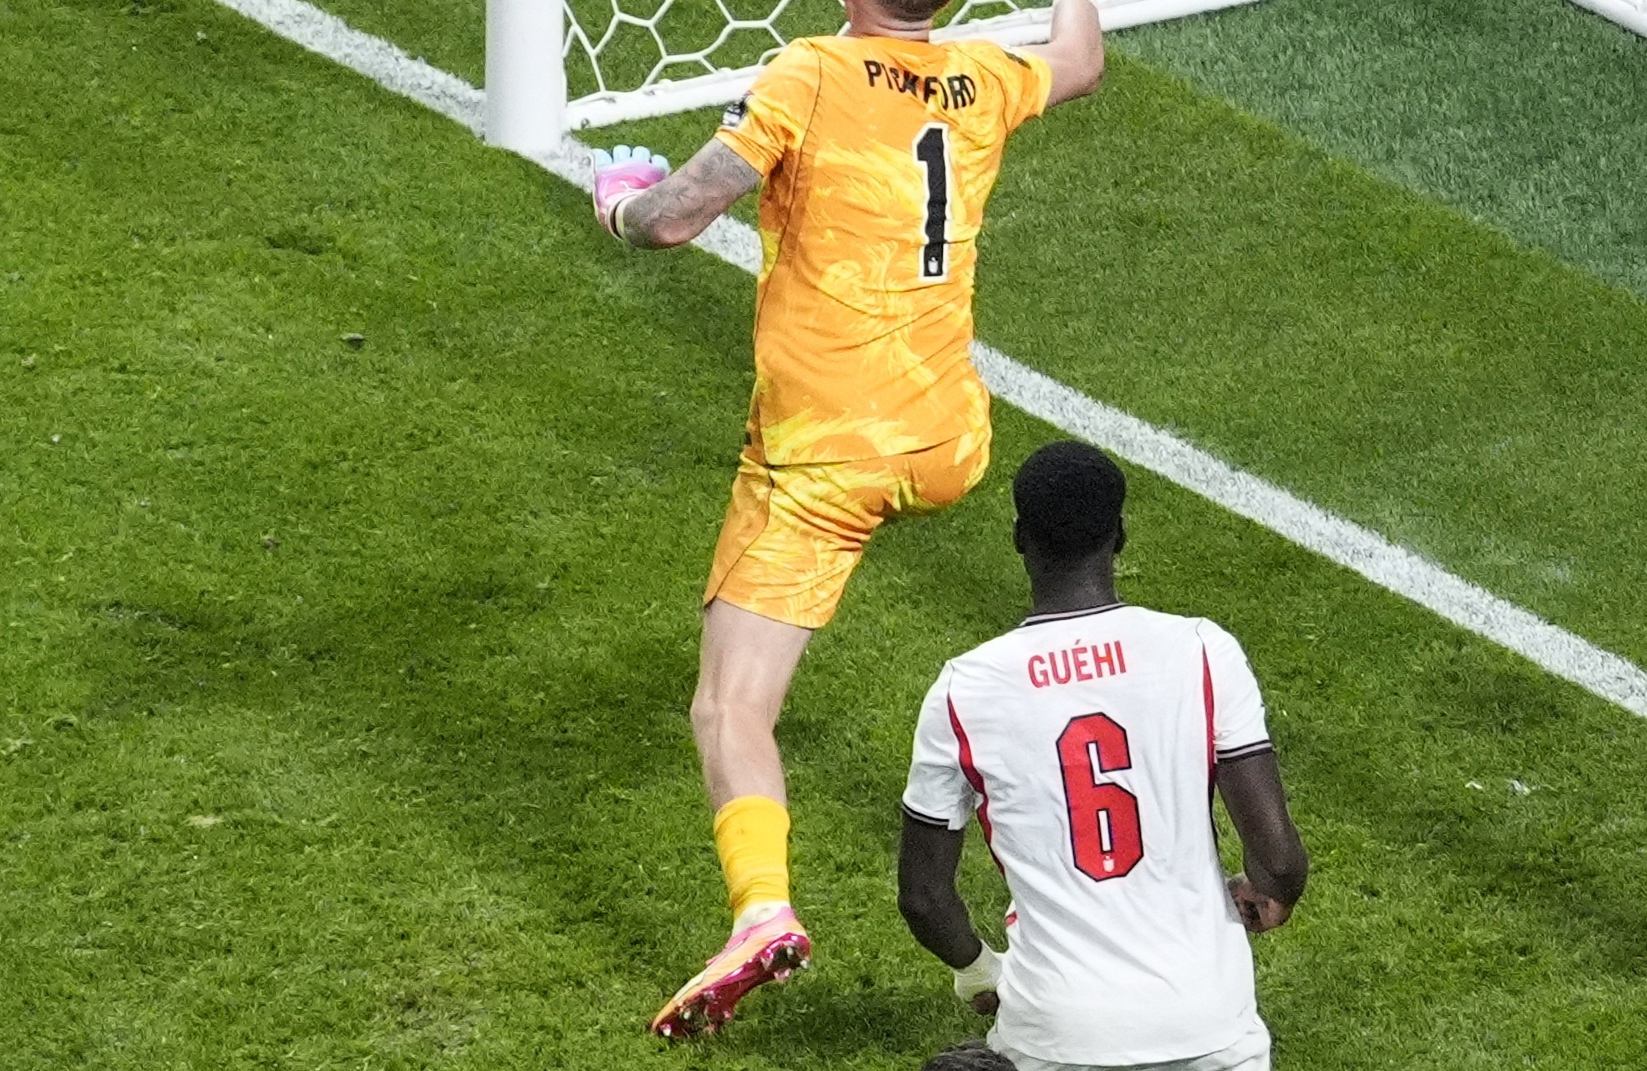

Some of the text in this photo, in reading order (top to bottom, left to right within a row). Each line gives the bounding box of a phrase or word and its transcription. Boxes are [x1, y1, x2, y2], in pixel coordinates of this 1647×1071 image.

[913, 123, 949, 281] 1
[1027, 639, 1127, 689] GUÉHI
[1056, 711, 1144, 882] 6
